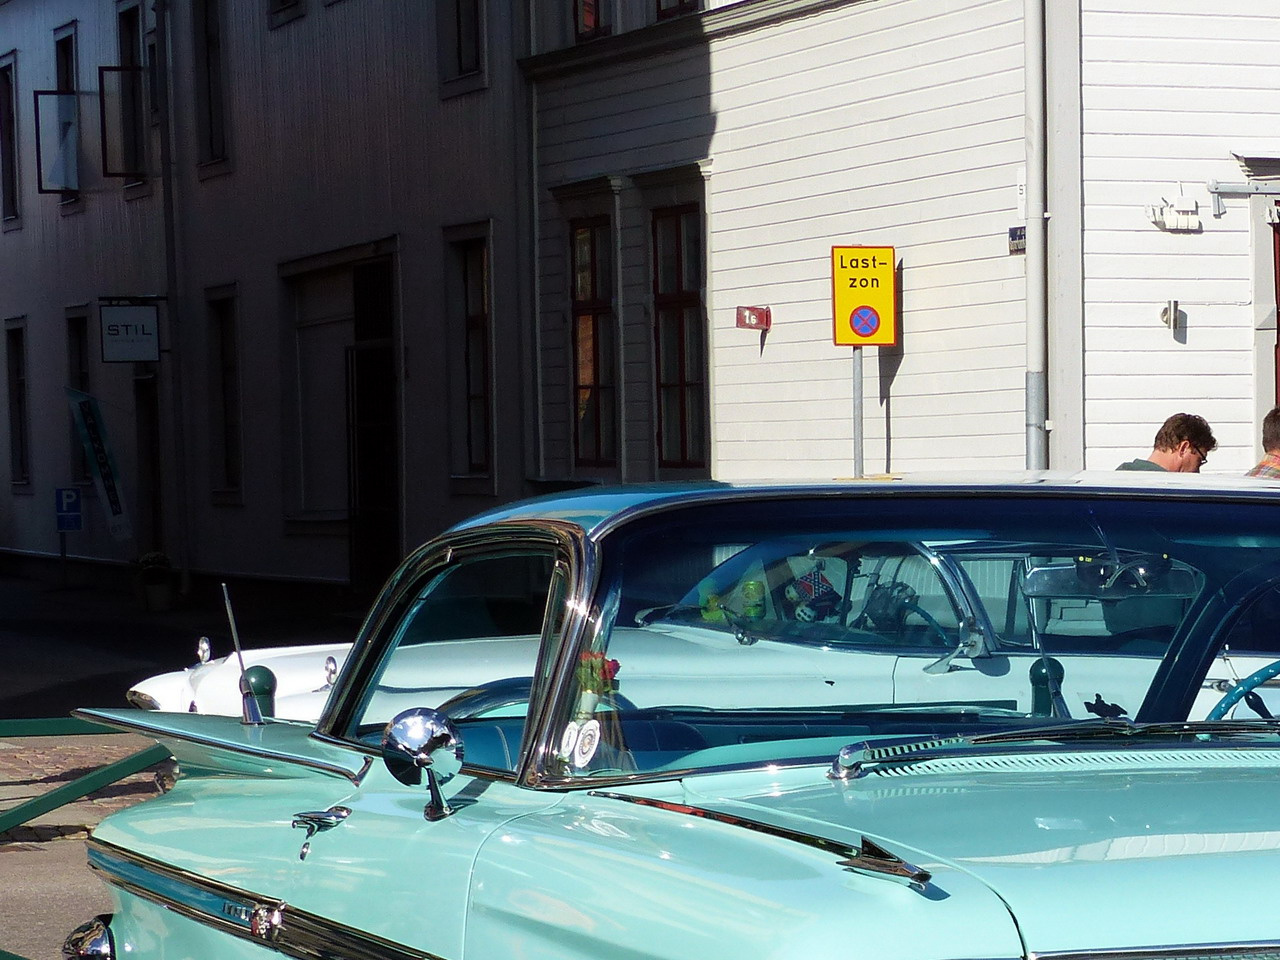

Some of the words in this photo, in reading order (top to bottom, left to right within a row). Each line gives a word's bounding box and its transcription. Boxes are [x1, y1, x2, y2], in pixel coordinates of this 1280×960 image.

[840, 255, 888, 269] Last-
[849, 277, 880, 288] zon
[744, 310, 757, 325] 16
[107, 324, 153, 336] STIL
[61, 490, 78, 511] P
